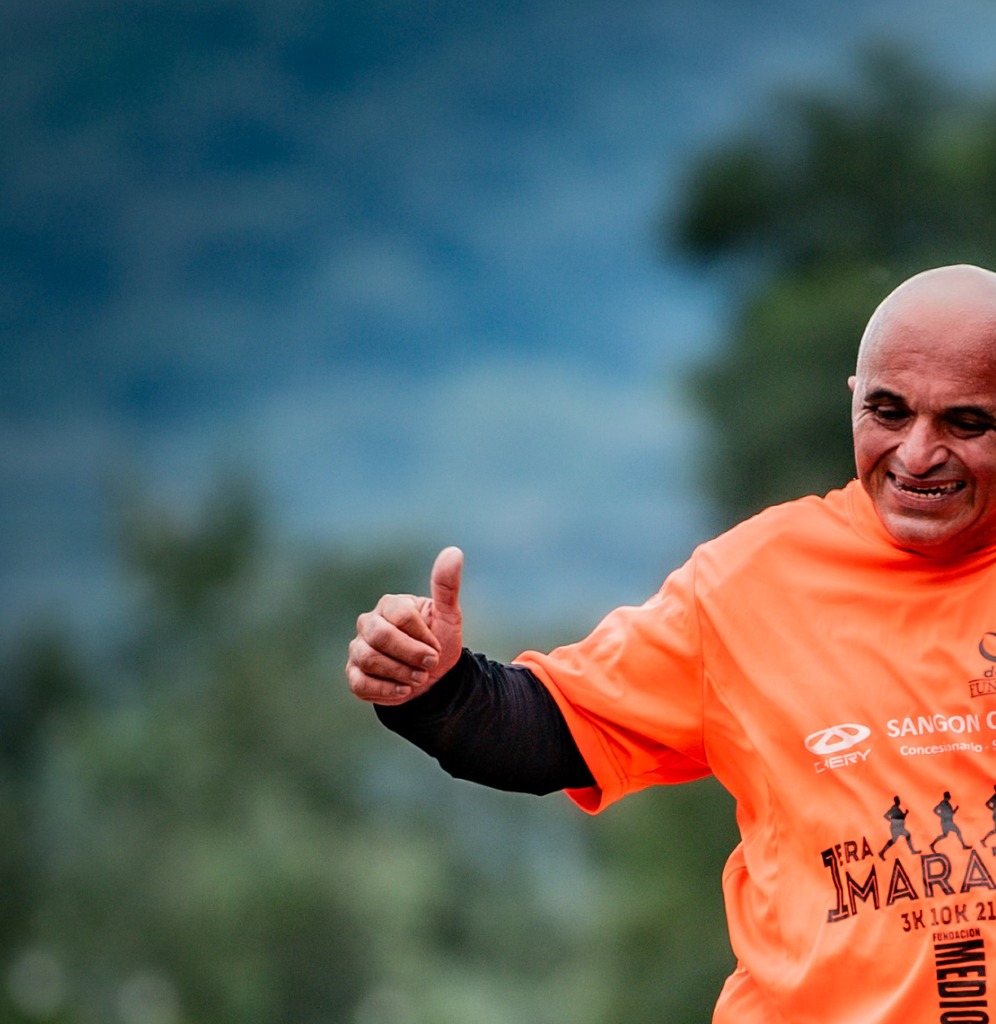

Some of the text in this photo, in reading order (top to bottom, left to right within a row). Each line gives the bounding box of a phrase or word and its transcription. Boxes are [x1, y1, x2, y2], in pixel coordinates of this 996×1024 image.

[886, 713, 981, 738] SANGON
[901, 909, 926, 932] 3K
[930, 904, 969, 926] 10K
[932, 928, 981, 942] FUNDACION
